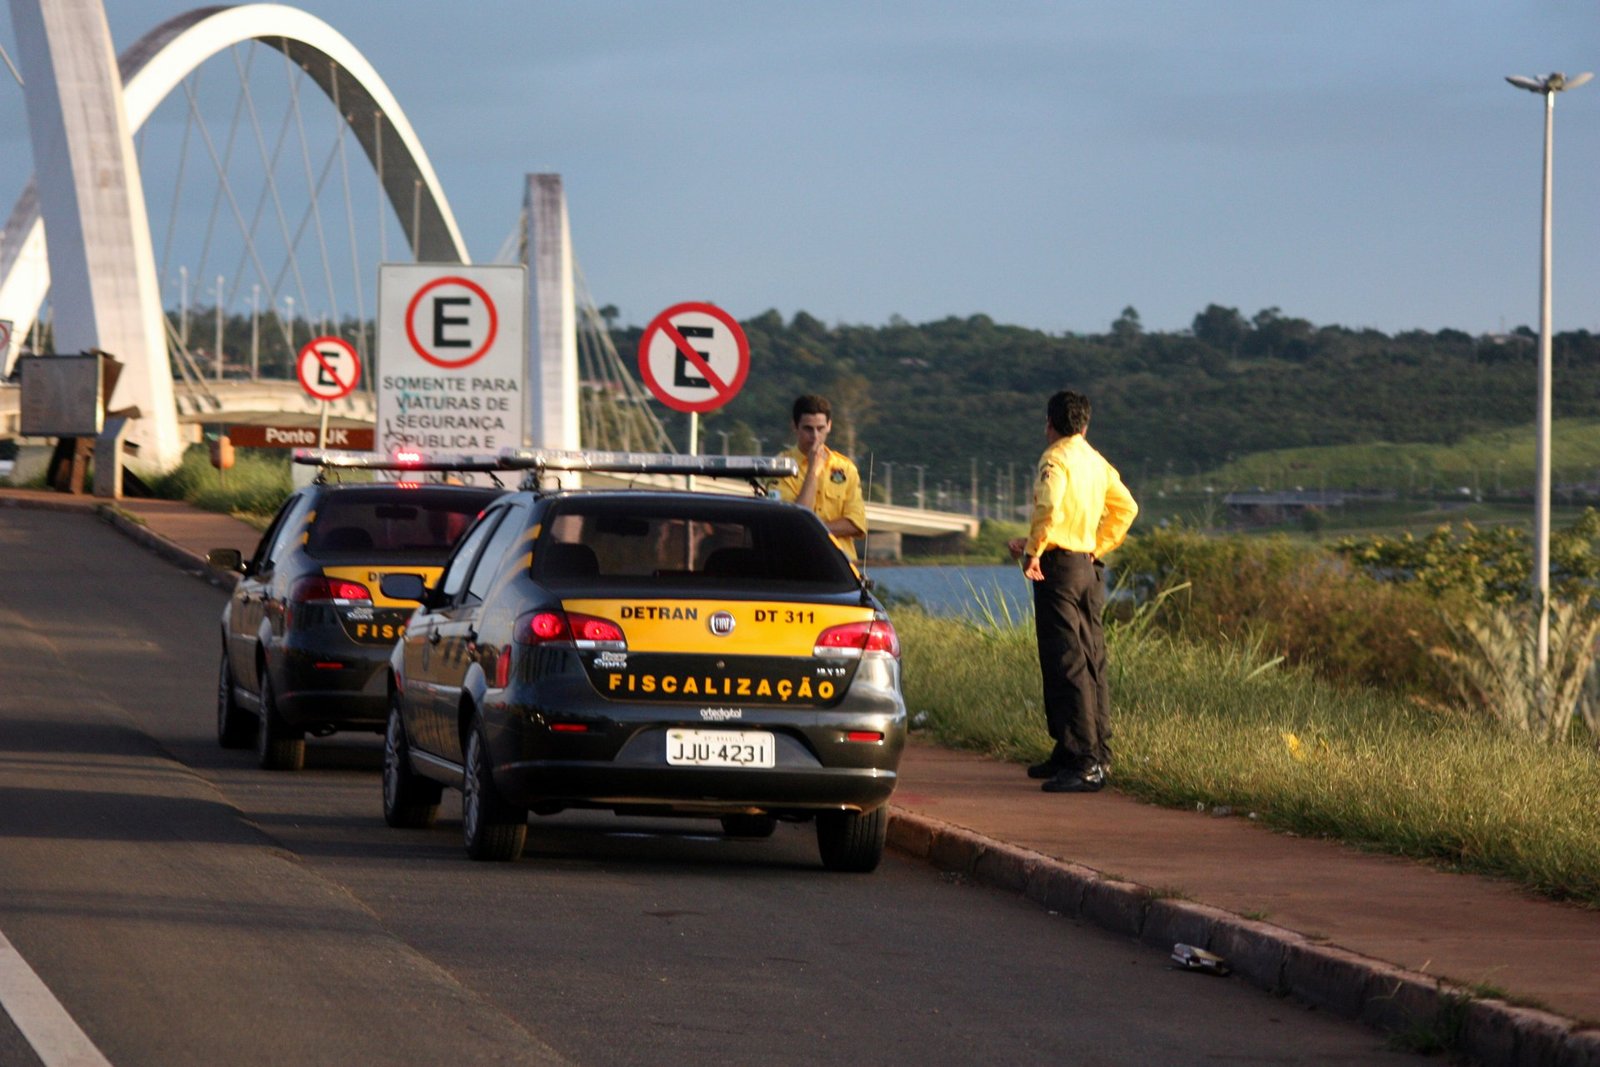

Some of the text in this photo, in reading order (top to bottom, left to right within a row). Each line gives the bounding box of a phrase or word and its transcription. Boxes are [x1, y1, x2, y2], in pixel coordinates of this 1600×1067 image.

[433, 297, 471, 348] E
[674, 326, 714, 389] E
[317, 351, 339, 386] E
[383, 376, 518, 392] SOMENTE PARA
[396, 396, 509, 411] VIATURAS DE
[396, 415, 505, 431] SEGURANÇA
[265, 427, 349, 444] Ponte JK
[484, 435, 496, 449] E
[620, 606, 698, 620] DETRAN
[754, 609, 815, 624] DT 311
[609, 673, 835, 701] FISCALIZAÇÃO
